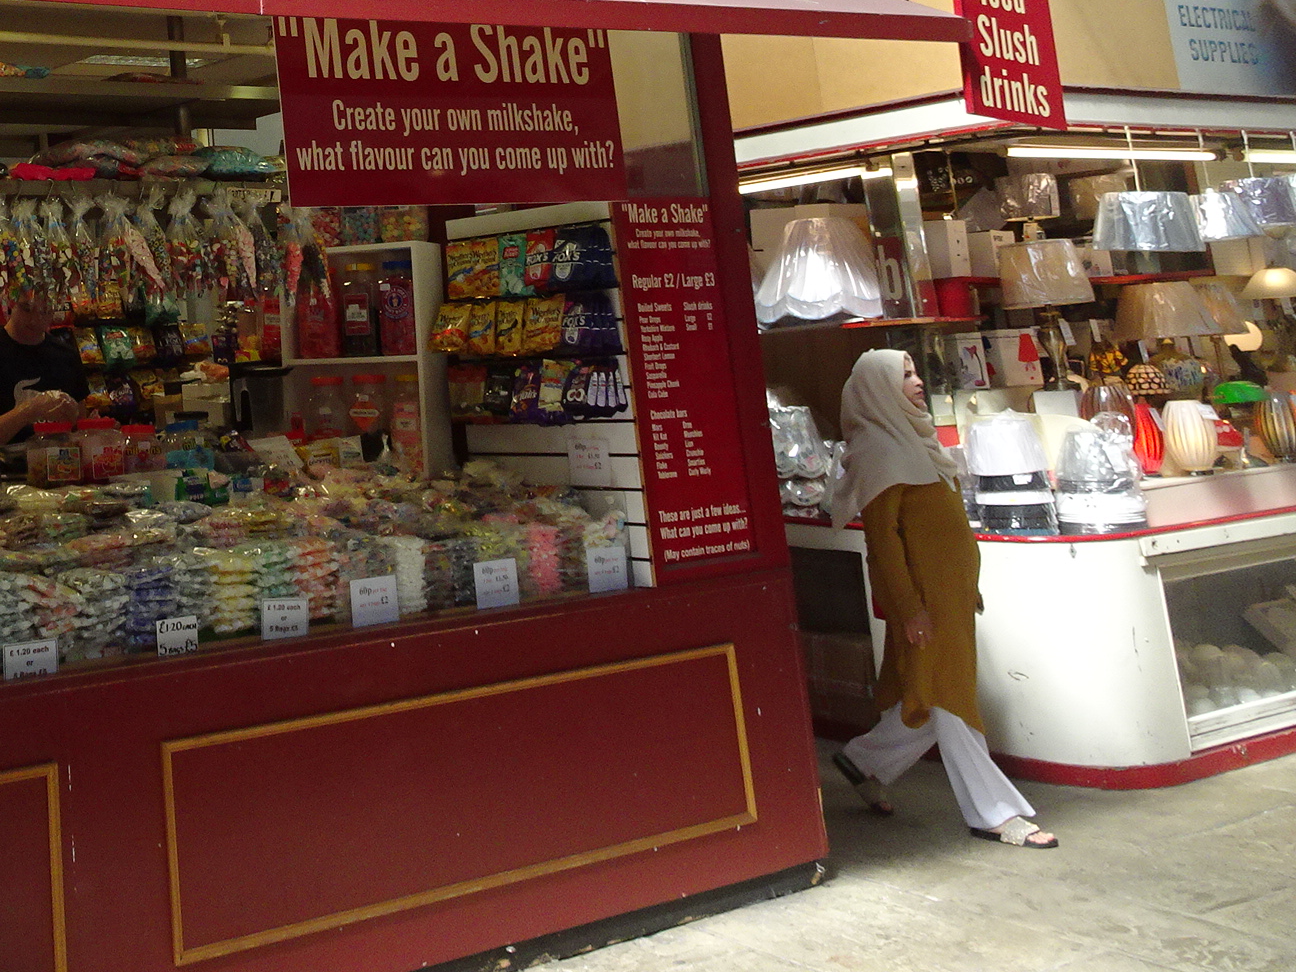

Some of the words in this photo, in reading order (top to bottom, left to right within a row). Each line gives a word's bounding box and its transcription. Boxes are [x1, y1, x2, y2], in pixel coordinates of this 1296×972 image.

[977, 14, 1040, 65] Slush
[279, 16, 419, 81] "Make
[434, 32, 459, 81] a
[470, 24, 604, 84] Shake"
[1189, 39, 1259, 65] SUPPLIES
[980, 66, 1050, 118] drinks
[332, 99, 396, 131] Create
[401, 105, 440, 136] your
[447, 108, 481, 131] own
[487, 103, 579, 135] milkshake,
[296, 140, 345, 171] what
[349, 140, 415, 171] flavour
[421, 147, 453, 170] can
[459, 145, 489, 176] you
[495, 145, 541, 170] come
[547, 146, 567, 174] up
[571, 140, 614, 168] with?
[621, 203, 658, 223] "Make
[661, 208, 668, 223] a
[670, 203, 708, 223] Shake"
[635, 228, 652, 237] Create
[653, 230, 664, 239] your
[627, 240, 640, 249] what
[640, 240, 657, 249] flavour
[668, 241, 676, 250] you
[691, 241, 698, 249] up
[552, 251, 581, 262] FOX'S
[632, 274, 662, 291] Regular
[663, 273, 674, 287] £2
[681, 273, 703, 290] Large
[704, 272, 715, 287] £3
[654, 302, 672, 312] Sweets
[562, 315, 585, 327] FOX'S
[650, 409, 676, 420] Chocolate
[658, 510, 678, 523] These
[679, 510, 690, 521] are
[691, 506, 704, 522] just
[705, 508, 710, 517] a
[710, 504, 722, 517] few
[660, 526, 678, 540] What
[678, 526, 691, 538] can
[691, 525, 704, 539] you
[704, 523, 722, 534] come
[722, 521, 731, 534] up
[731, 516, 748, 531] with?
[664, 549, 680, 563] (May
[680, 545, 706, 558] contain
[705, 544, 725, 555] traces
[726, 541, 733, 552] of
[733, 539, 750, 551] nuts)
[17, 648, 31, 656] 1.20
[32, 646, 49, 654] each
